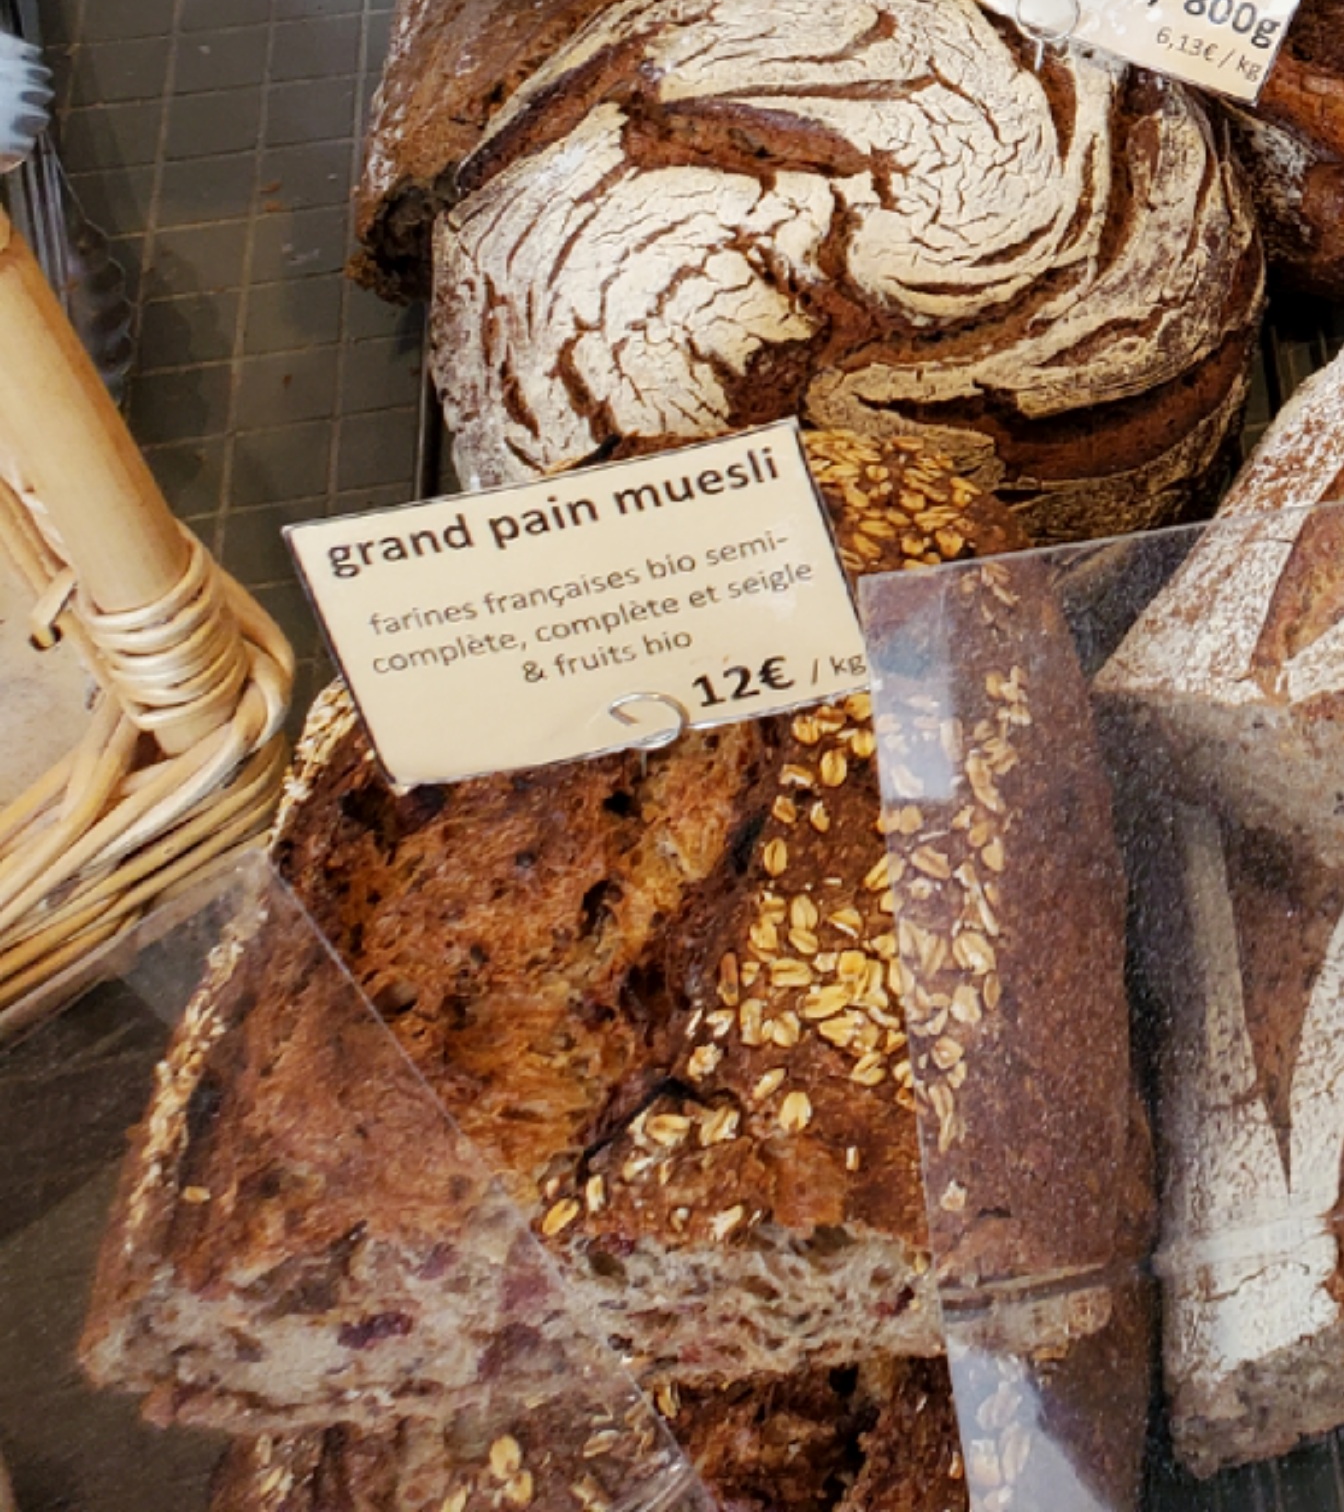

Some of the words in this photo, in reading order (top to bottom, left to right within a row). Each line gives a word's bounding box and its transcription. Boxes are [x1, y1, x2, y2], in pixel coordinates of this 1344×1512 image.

[1156, 25, 1217, 66] 6,13€
[1237, 54, 1261, 81] kg
[328, 512, 474, 579] grand
[488, 493, 600, 550] pain
[613, 447, 780, 516] muesli
[370, 600, 478, 637] farines
[484, 566, 641, 618] françaises
[646, 551, 697, 581] bio
[706, 533, 789, 567] semi-
[372, 630, 527, 676] complète,
[534, 595, 680, 645] complète
[689, 585, 721, 610] et
[728, 563, 813, 599] seigle
[521, 659, 549, 685] &
[554, 644, 637, 679] fruits
[645, 626, 694, 656] bio
[691, 654, 795, 709] 12€
[829, 653, 867, 677] kg
